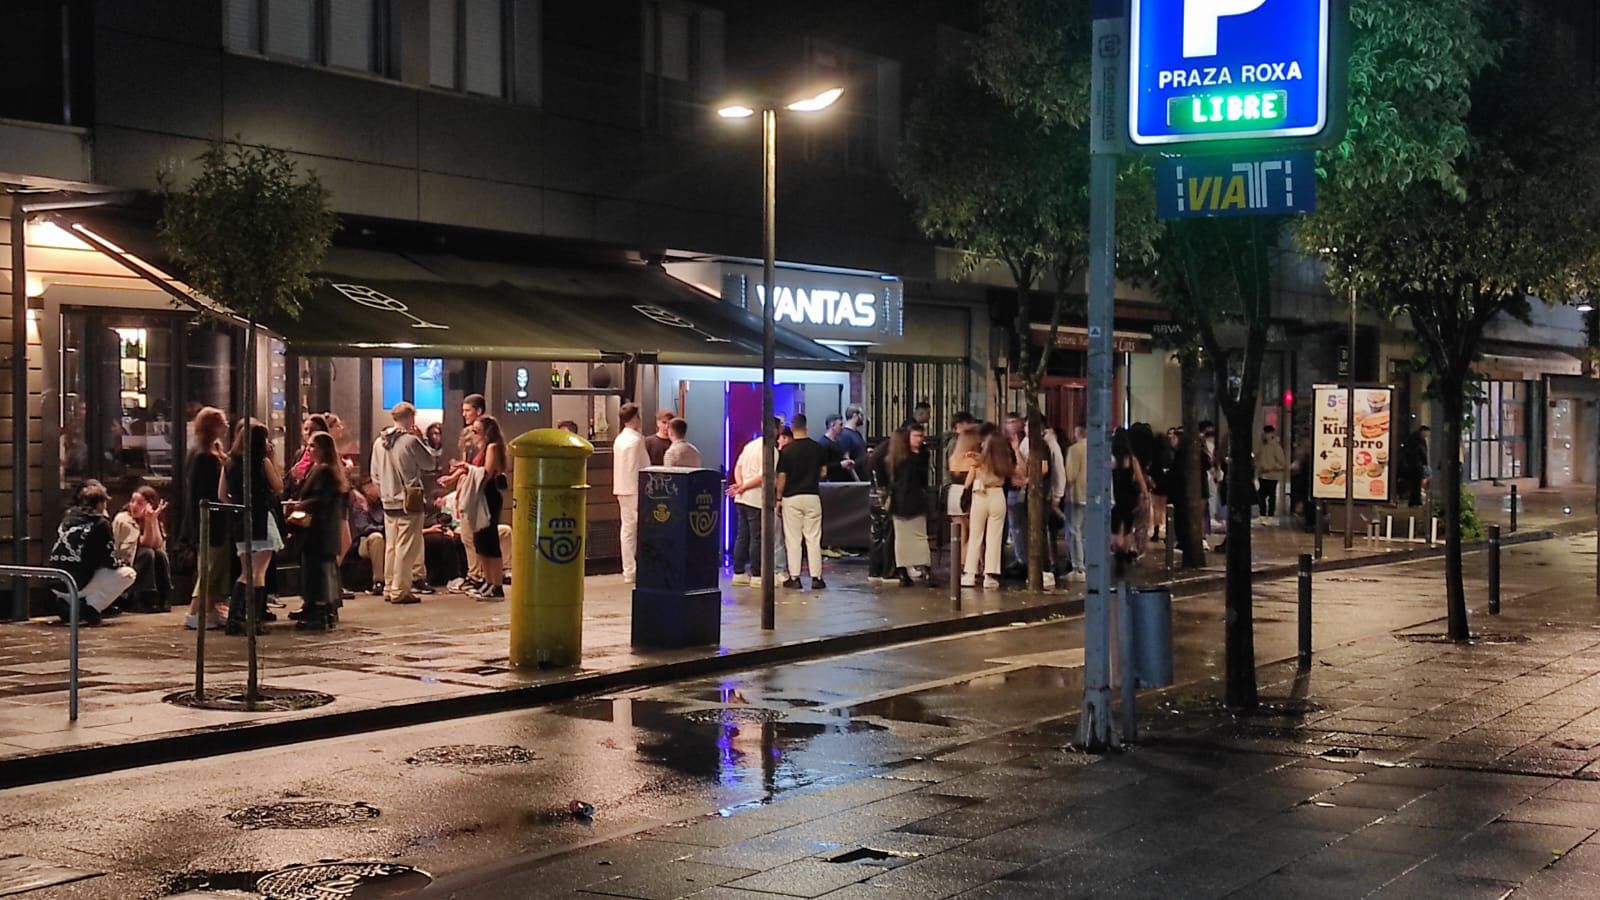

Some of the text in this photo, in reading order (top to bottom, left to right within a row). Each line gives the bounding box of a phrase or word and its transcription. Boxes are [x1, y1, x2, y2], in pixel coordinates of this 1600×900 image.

[1158, 61, 1302, 89] PRAZA ROXA
[1191, 93, 1278, 123] LIBRE
[756, 285, 876, 327] VANITAS
